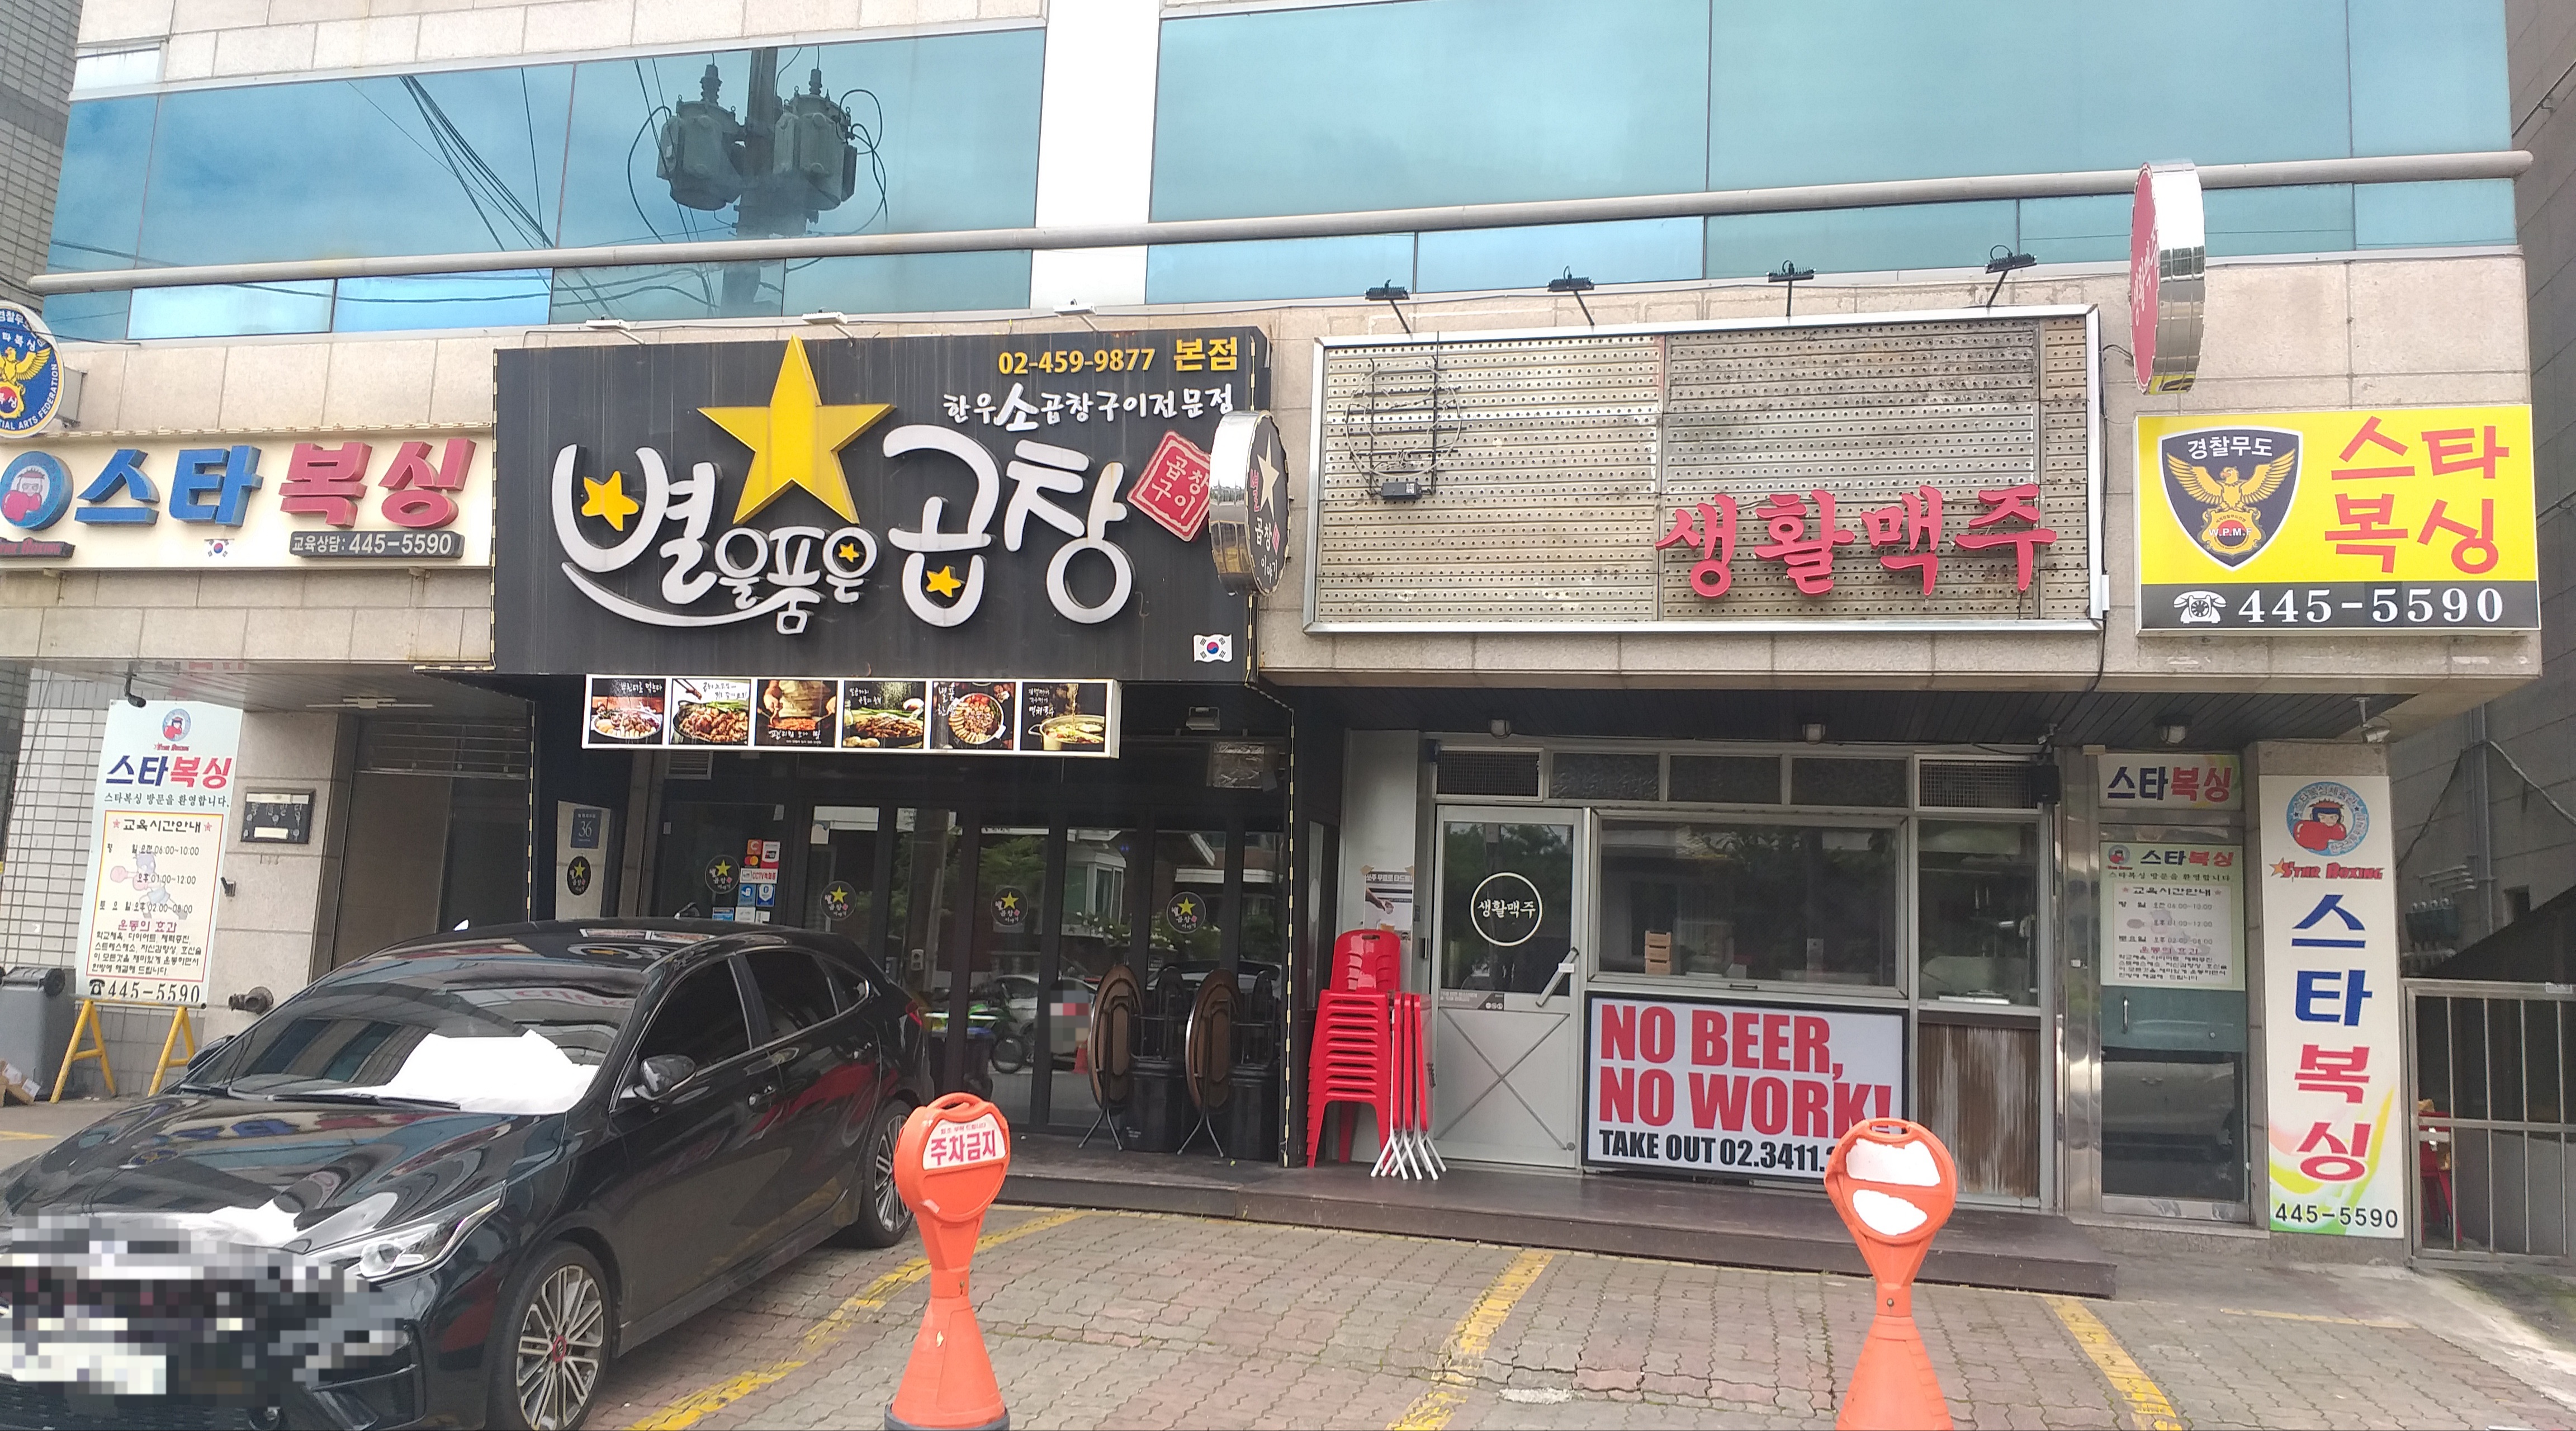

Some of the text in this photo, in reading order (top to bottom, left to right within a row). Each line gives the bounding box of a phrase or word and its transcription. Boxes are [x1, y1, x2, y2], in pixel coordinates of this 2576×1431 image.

[998, 336, 1238, 375] 02-459-9877 본점
[18, 415, 38, 430] ARTS
[38, 363, 58, 419] FEDERATION
[2187, 436, 2273, 460] 경찰무도
[2331, 416, 2510, 481] 스타
[74, 438, 477, 529] 스타 복싱
[1152, 478, 1196, 519] 구이
[349, 533, 452, 554] 445-5590
[883, 424, 1132, 627] 곱창
[1255, 517, 1272, 551] 곱창
[1654, 483, 2058, 598] 생활맥주
[2325, 492, 2499, 575] 복싱
[1261, 555, 1278, 584] 이야기
[2238, 587, 2504, 625] 445-5590
[105, 755, 233, 789] 스타복싱
[2107, 766, 2233, 802] 스타복싱
[104, 792, 142, 805] 스타복싱
[146, 793, 174, 806] 방문을
[123, 819, 202, 833] 교육시간안내
[578, 820, 593, 838] 36
[2140, 849, 2234, 867] 스타복싱
[119, 919, 150, 932] 운동의
[1477, 899, 1536, 920] 생활맥주
[108, 980, 200, 1003] 445-5590
[1599, 1004, 1843, 1080] NO BEER,
[1599, 1065, 1893, 1139] NO WORK!
[930, 1130, 997, 1166] 주차금지
[1598, 1129, 1836, 1173] TAKE OUT 02.3411.
[2275, 1201, 2398, 1229] 445-5590
